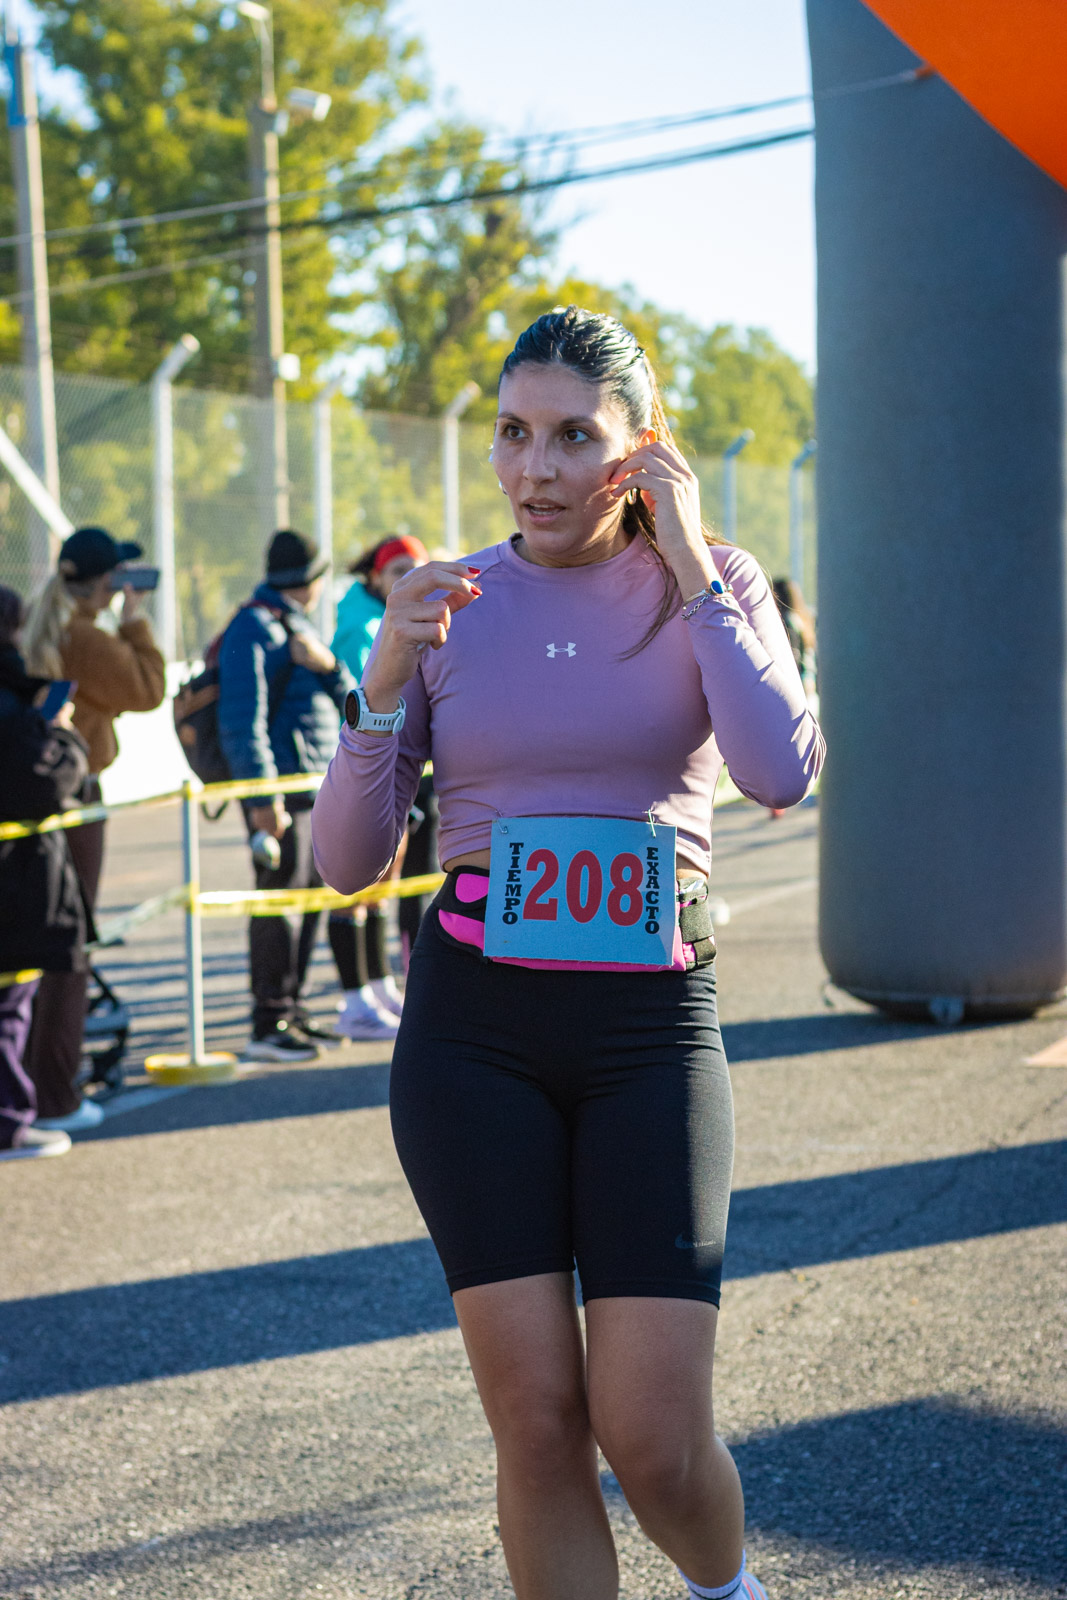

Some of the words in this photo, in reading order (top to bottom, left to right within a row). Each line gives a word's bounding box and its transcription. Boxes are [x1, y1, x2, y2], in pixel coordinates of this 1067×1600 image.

[502, 842, 524, 925] TIEMPO
[522, 848, 644, 927] 208
[645, 846, 660, 935] EXACTO
